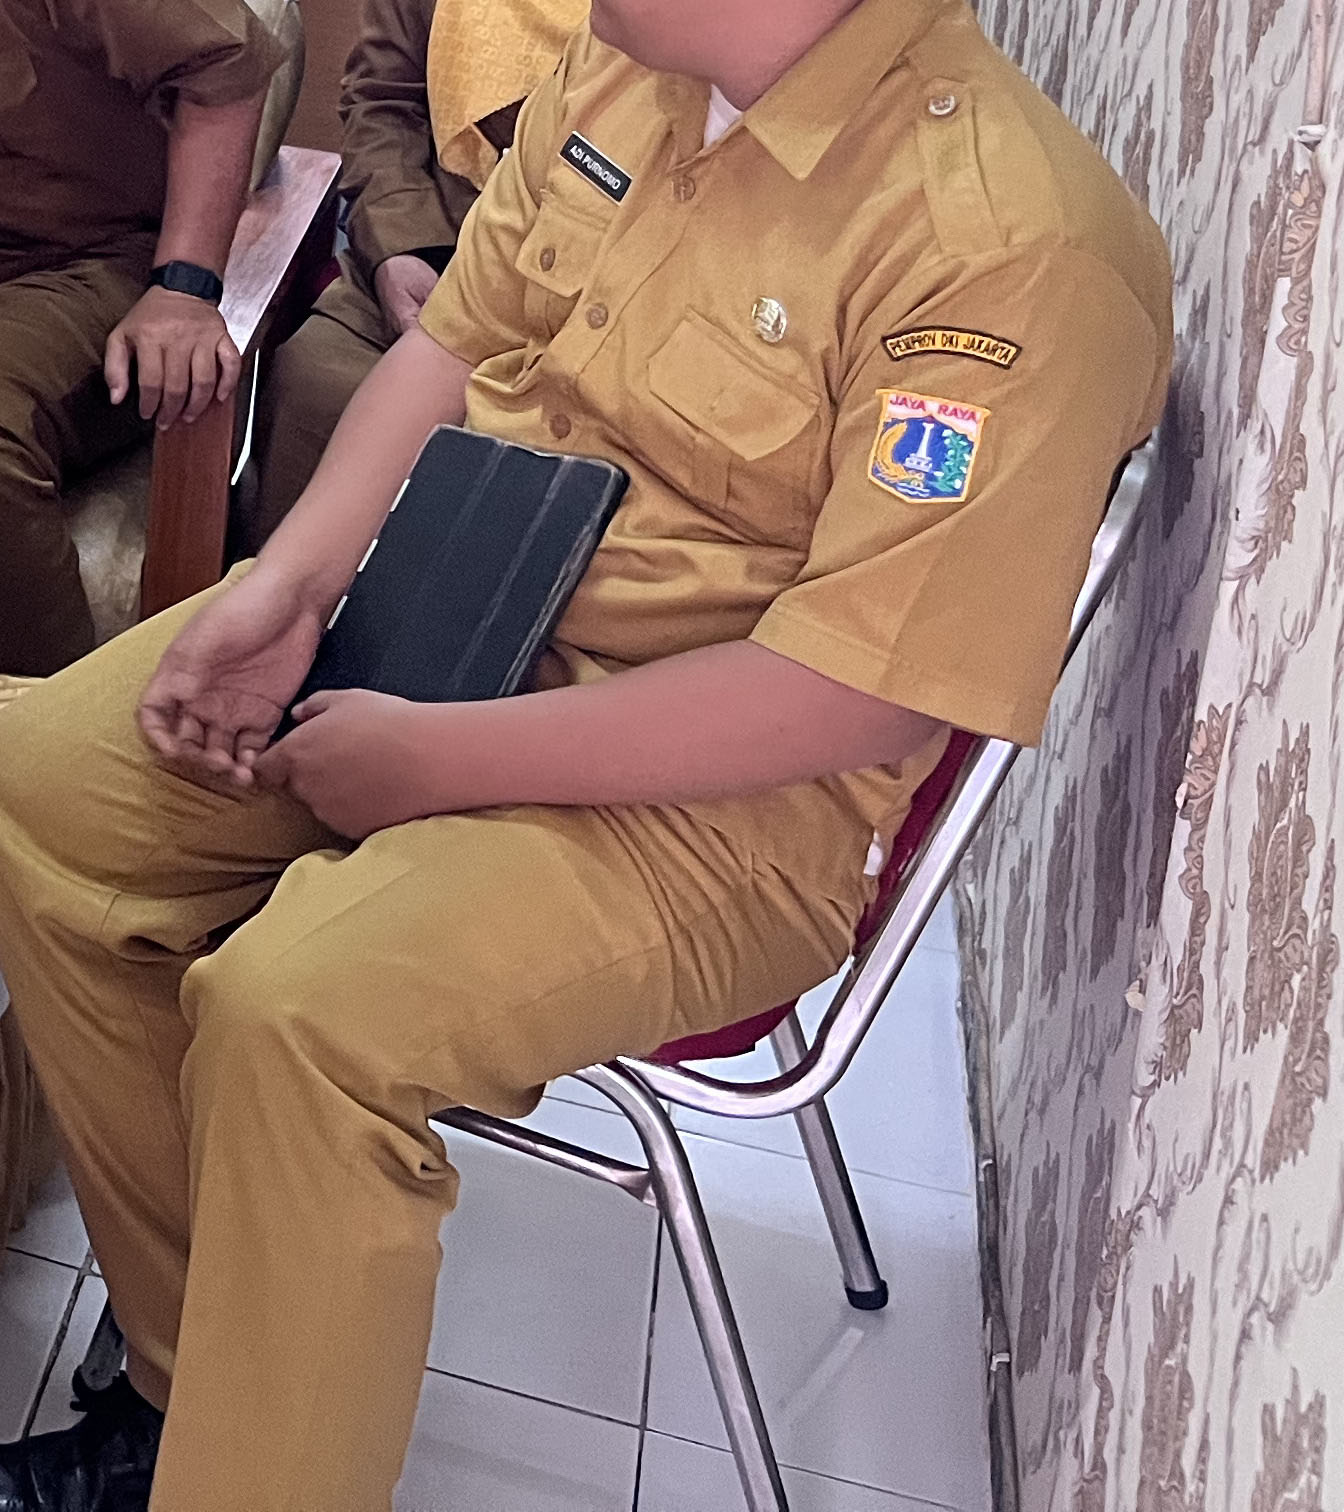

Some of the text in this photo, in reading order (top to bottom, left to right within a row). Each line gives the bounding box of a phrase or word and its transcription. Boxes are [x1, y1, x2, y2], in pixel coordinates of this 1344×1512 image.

[570, 144, 585, 161] ADI
[889, 332, 1012, 363] PEMPROV DKI JAKARTA
[889, 394, 978, 423] JAYA RAYA
